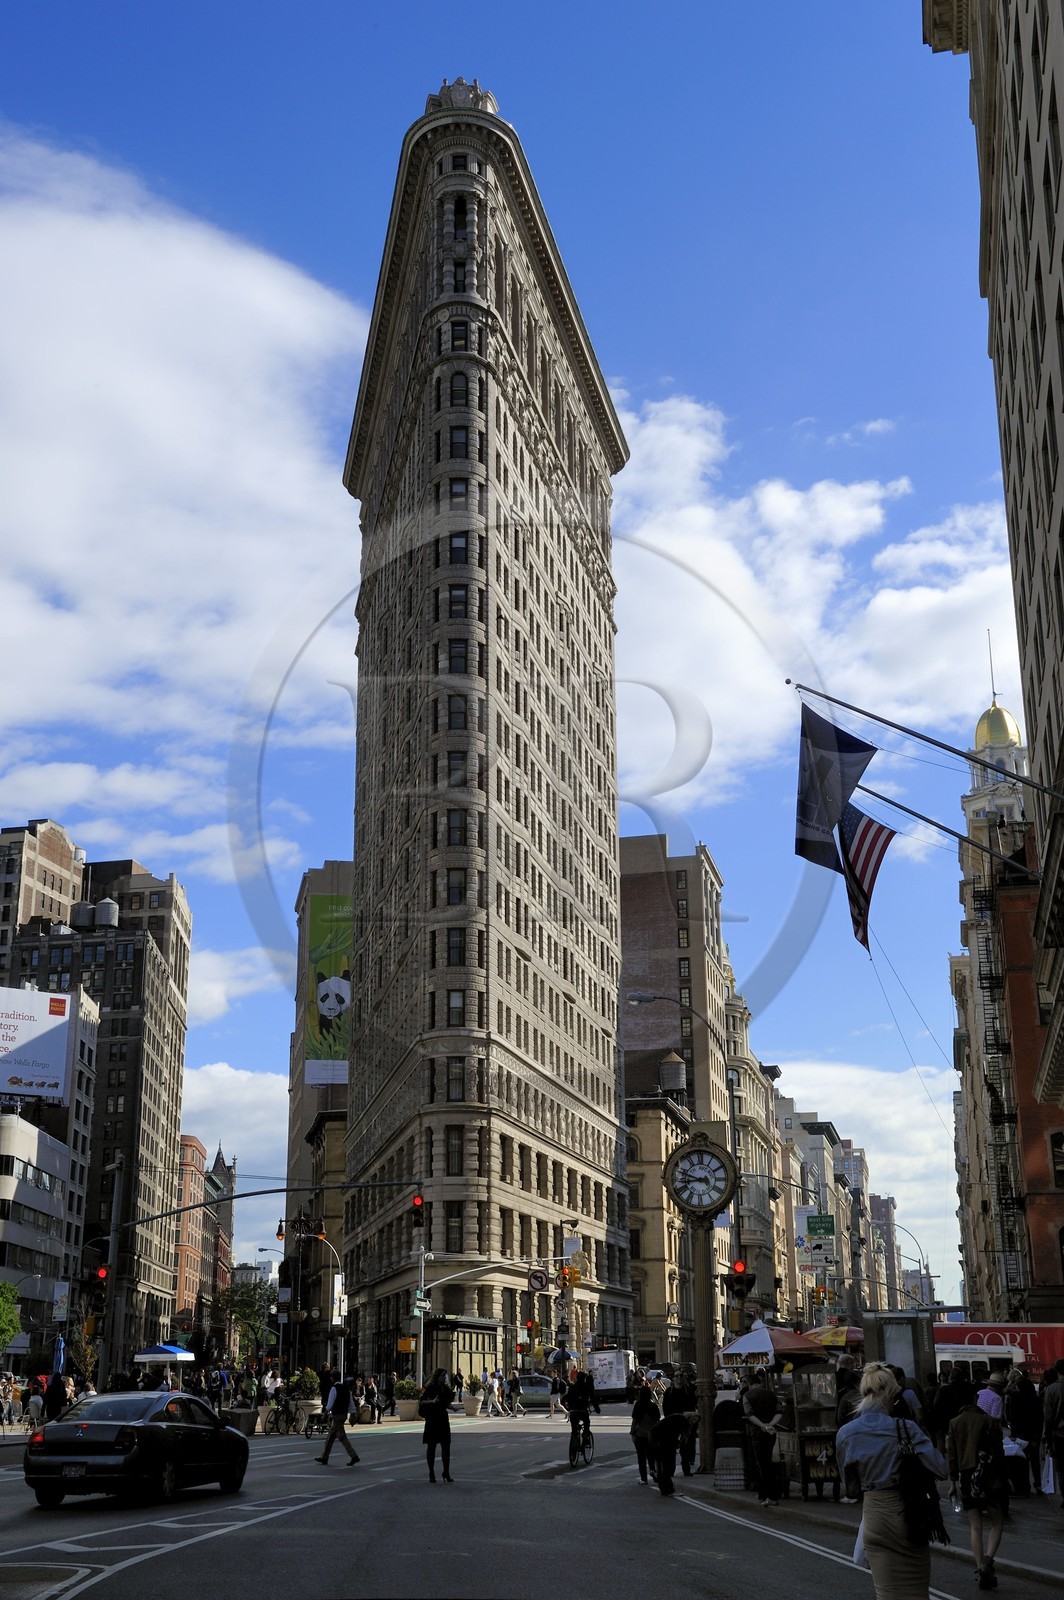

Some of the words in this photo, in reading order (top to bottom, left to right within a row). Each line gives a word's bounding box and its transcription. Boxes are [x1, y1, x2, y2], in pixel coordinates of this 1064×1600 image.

[0, 1010, 38, 1021] radition.
[1, 1033, 17, 1043] the
[14, 1058, 31, 1067] Wells
[31, 1060, 50, 1069] Fargo
[964, 1331, 1038, 1356] CORT
[722, 1353, 743, 1365] NUTS
[748, 1352, 770, 1365] NUTS
[804, 1440, 834, 1457] NUTS
[816, 1449, 829, 1465] 4
[809, 1462, 839, 1479] NUTS
